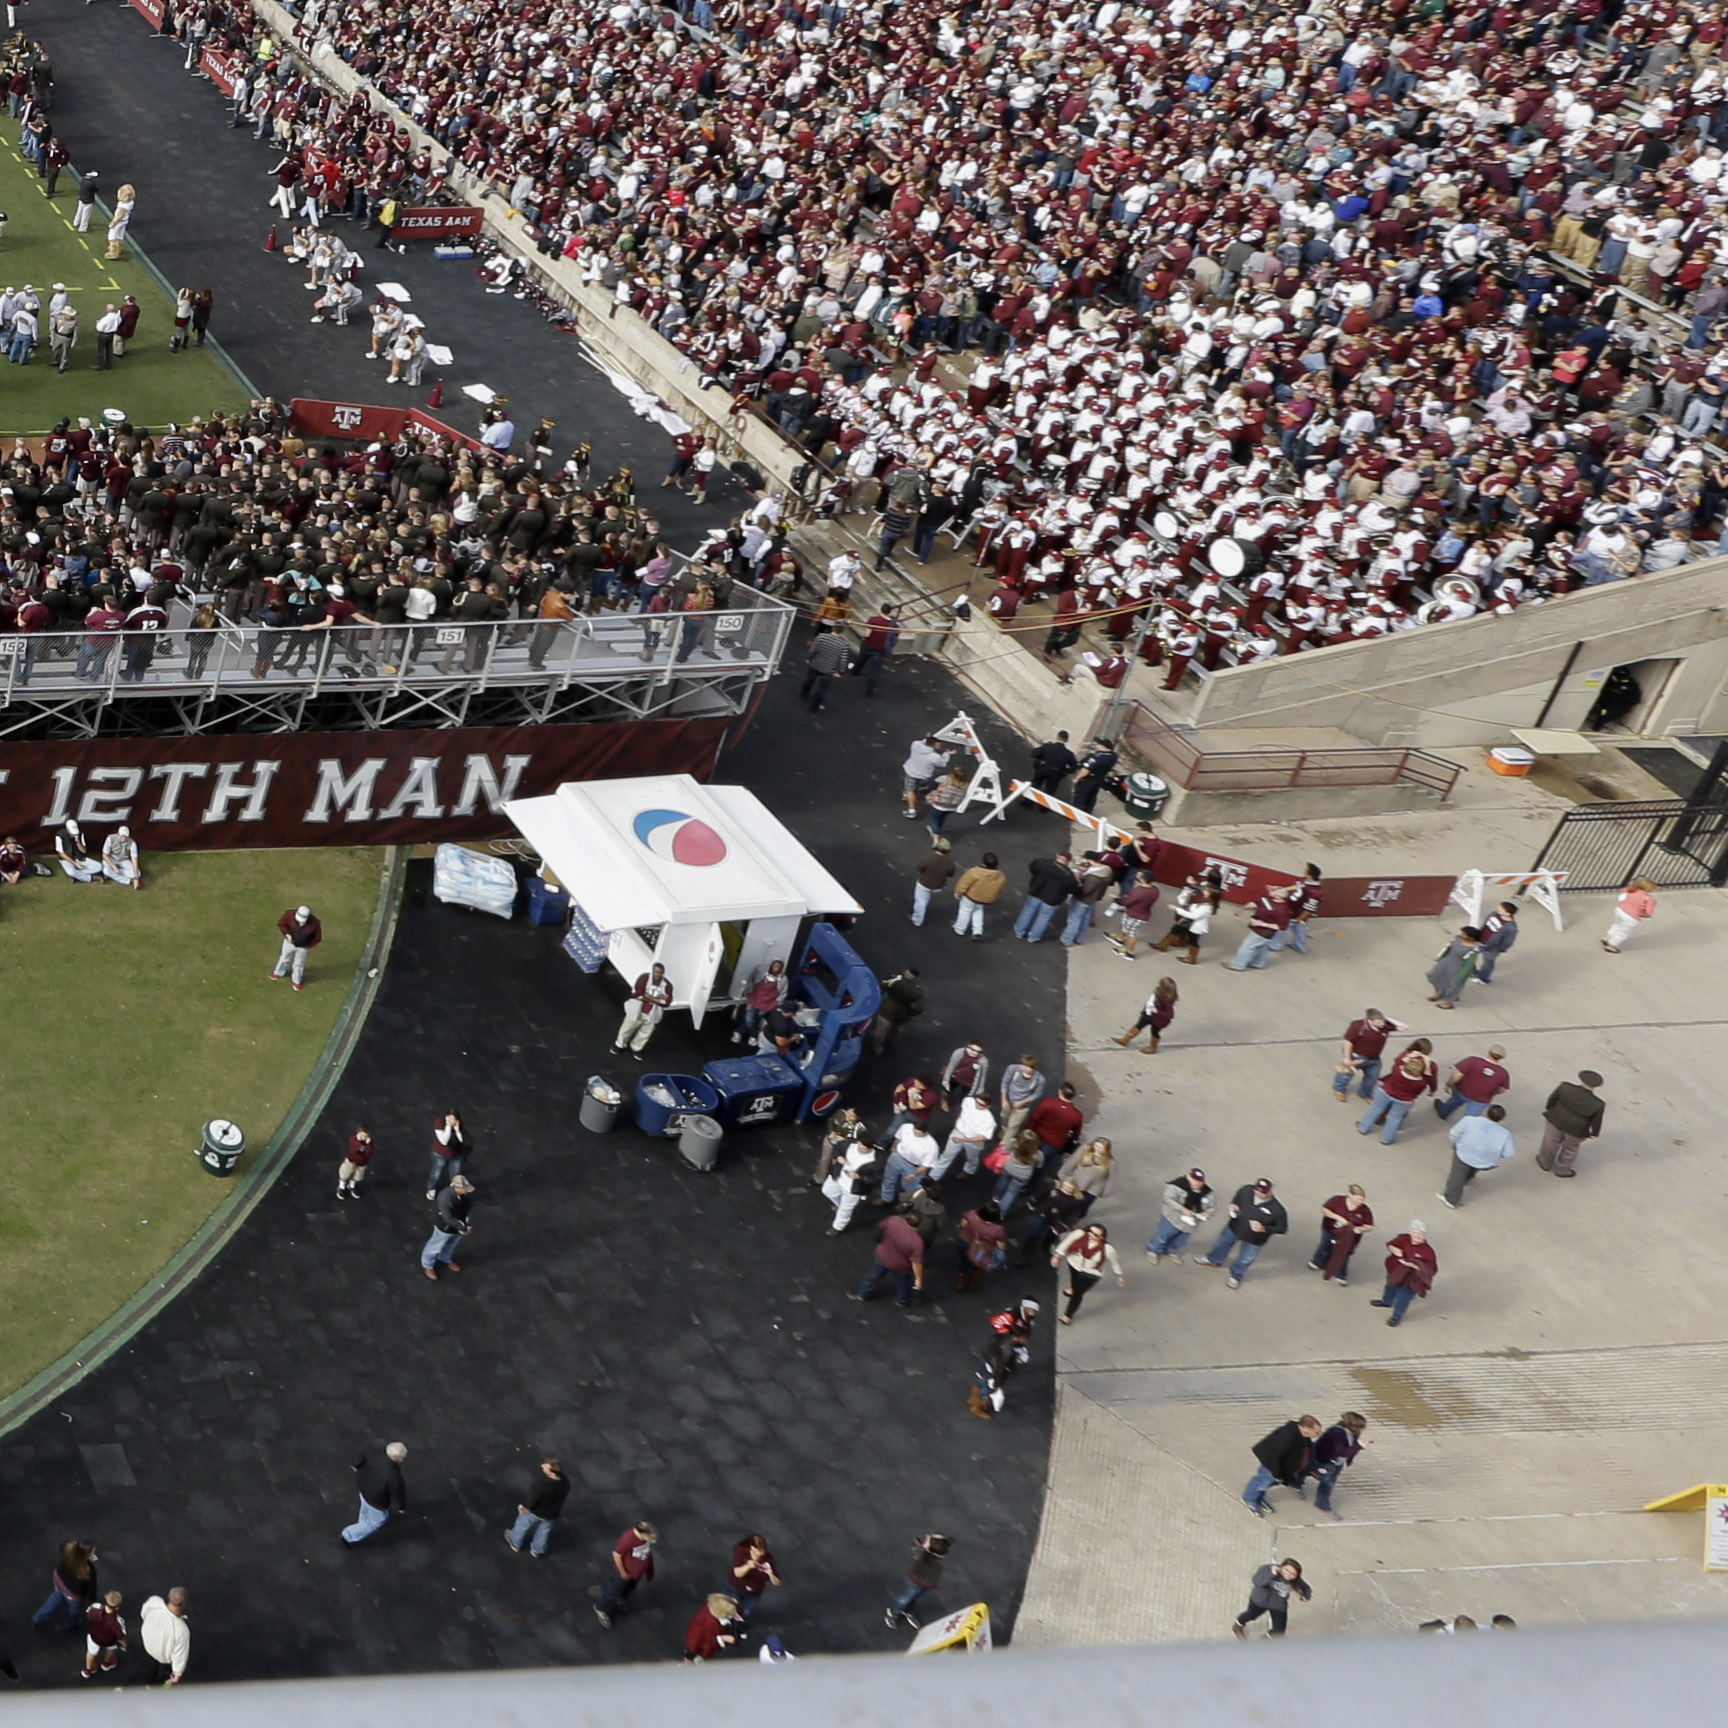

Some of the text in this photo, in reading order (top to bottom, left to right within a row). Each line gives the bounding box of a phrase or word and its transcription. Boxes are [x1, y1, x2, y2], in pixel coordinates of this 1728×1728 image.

[206, 53, 224, 76] TEXAS
[401, 216, 471, 228] TEXAS A&M
[413, 422, 441, 445] TEX
[717, 618, 742, 628] 150
[440, 631, 463, 641] 151
[1, 642, 25, 653] 152
[41, 760, 280, 827] 12TH
[303, 753, 532, 825] MAN
